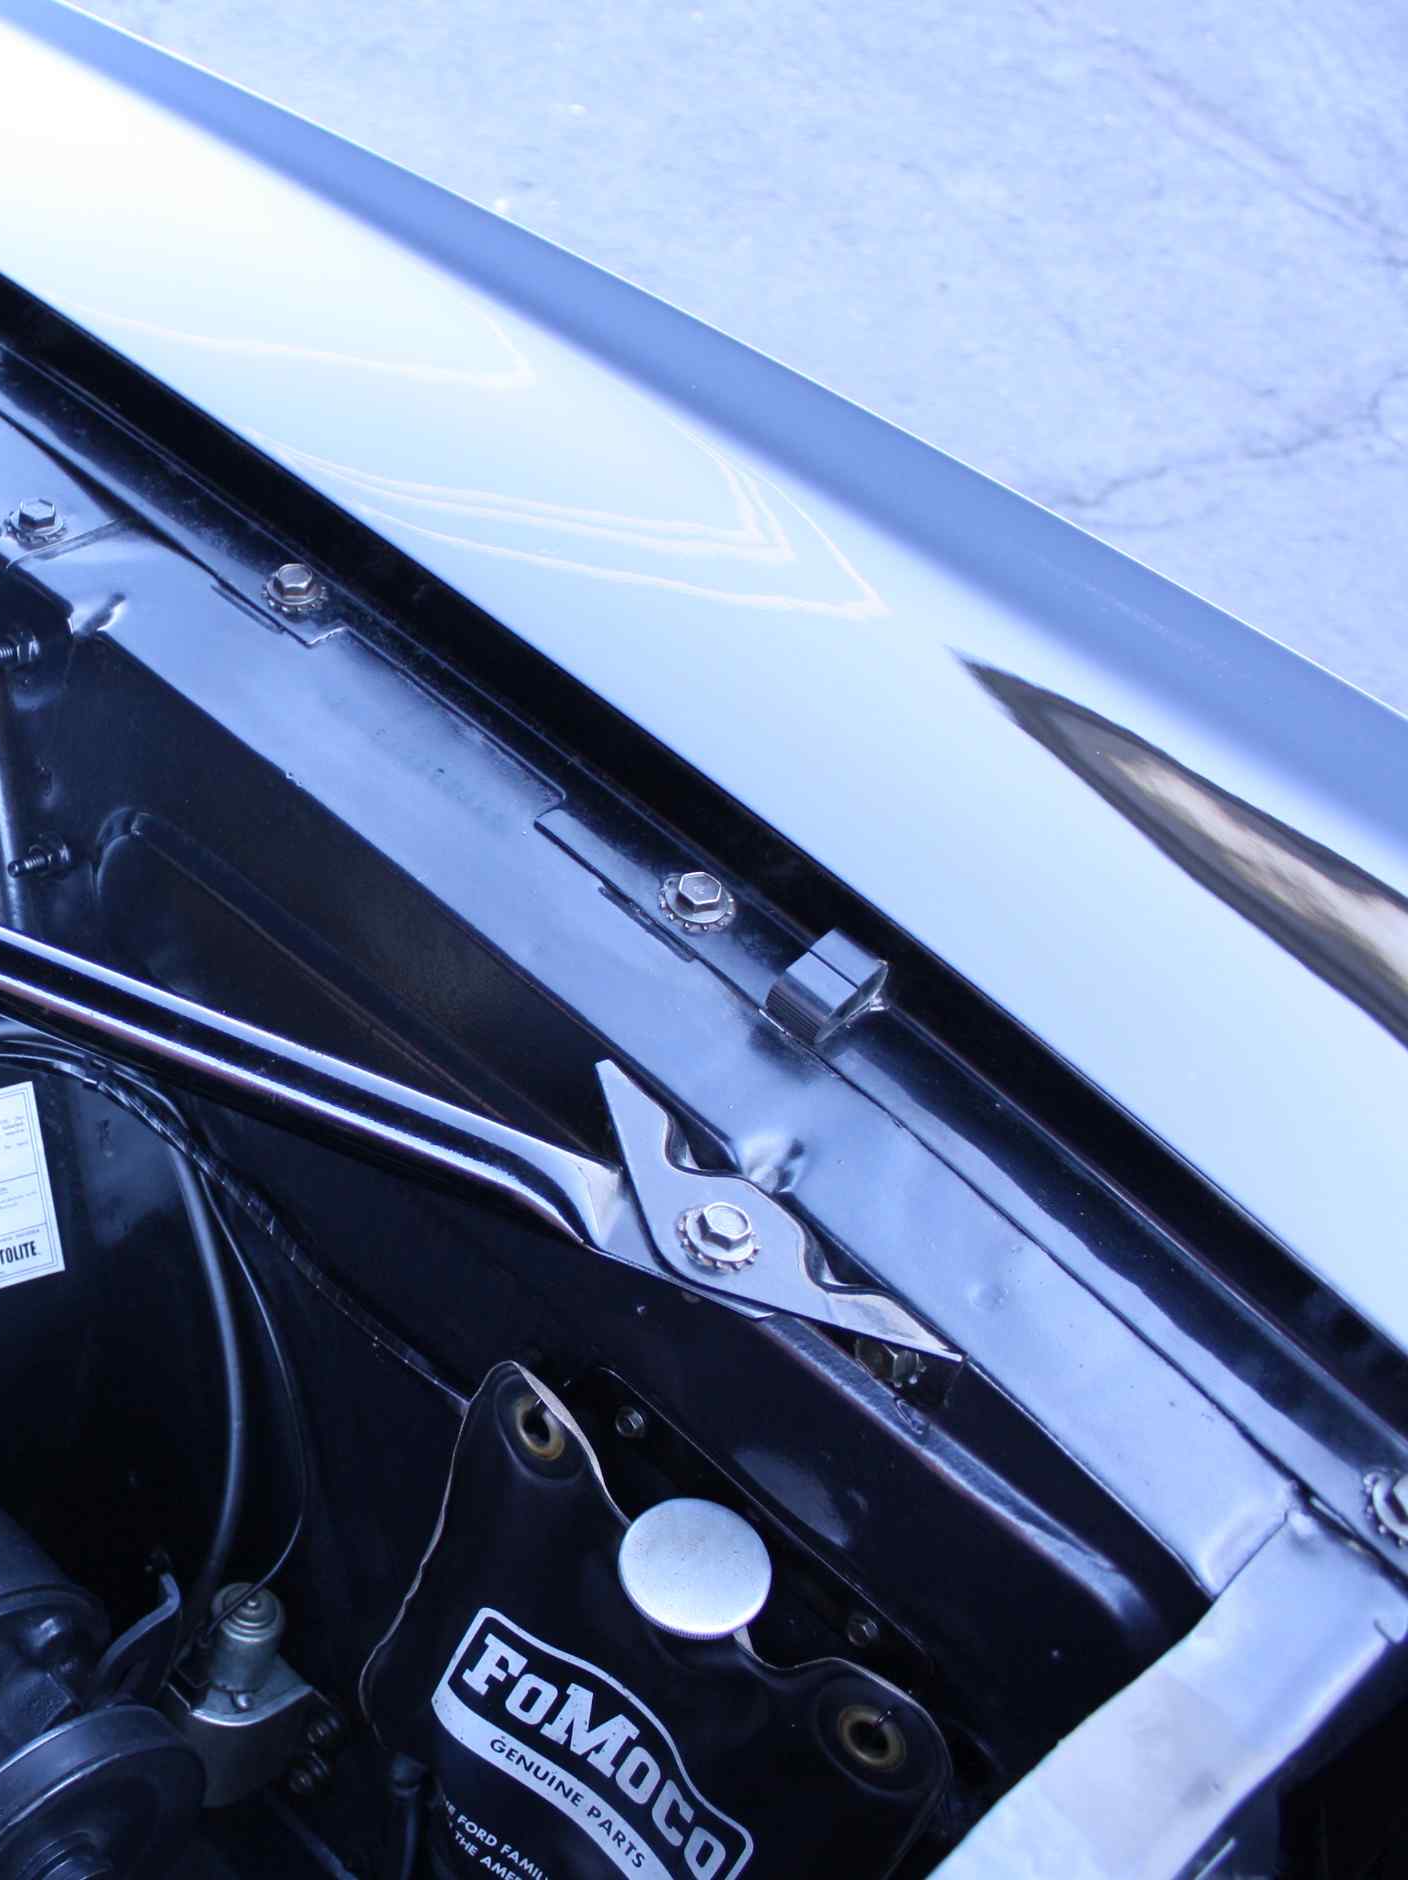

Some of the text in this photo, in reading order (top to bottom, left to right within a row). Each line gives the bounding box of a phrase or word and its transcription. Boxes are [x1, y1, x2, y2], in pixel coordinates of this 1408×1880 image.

[490, 1739, 645, 1868] GENUINE PARTS
[455, 1830, 479, 1856] THE
[457, 1814, 498, 1847] FORD
